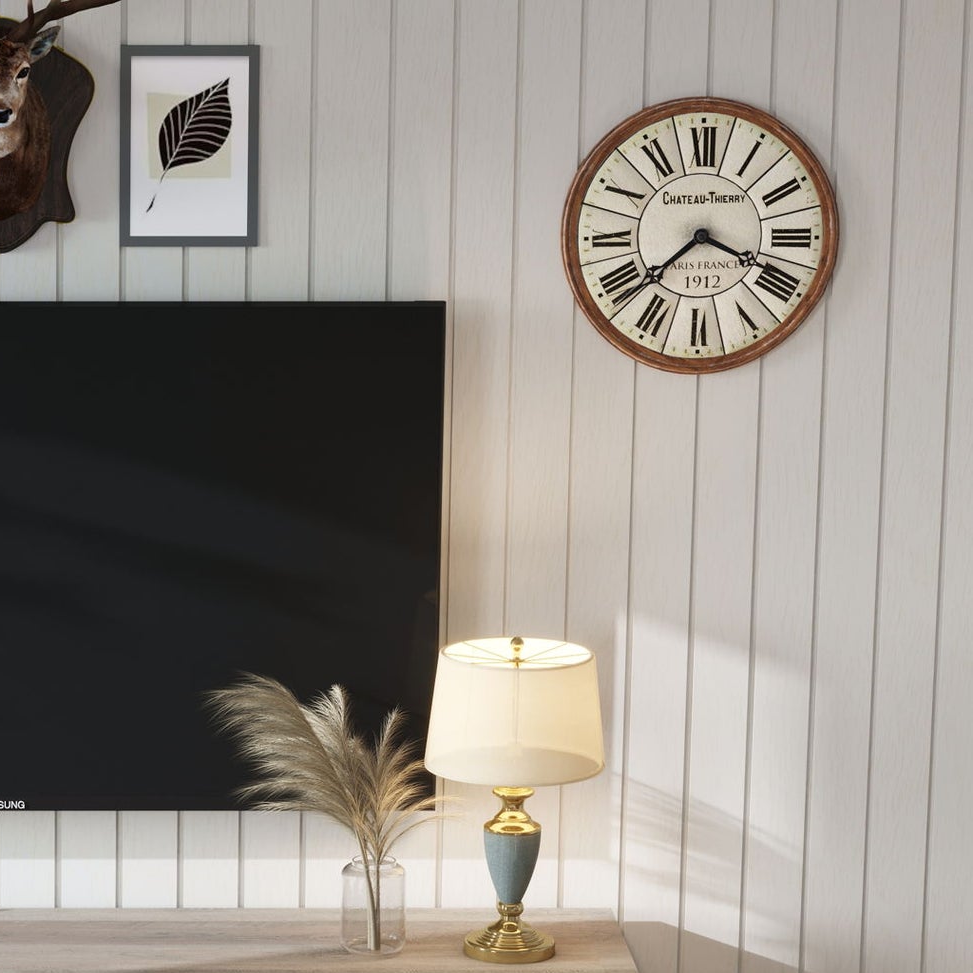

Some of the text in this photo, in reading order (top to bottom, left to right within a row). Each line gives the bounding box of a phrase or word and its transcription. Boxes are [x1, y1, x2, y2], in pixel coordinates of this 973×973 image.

[689, 127, 717, 168] XII
[771, 228, 811, 248] III
[665, 260, 740, 270] ARIS FRANCE
[684, 275, 721, 289] 1912
